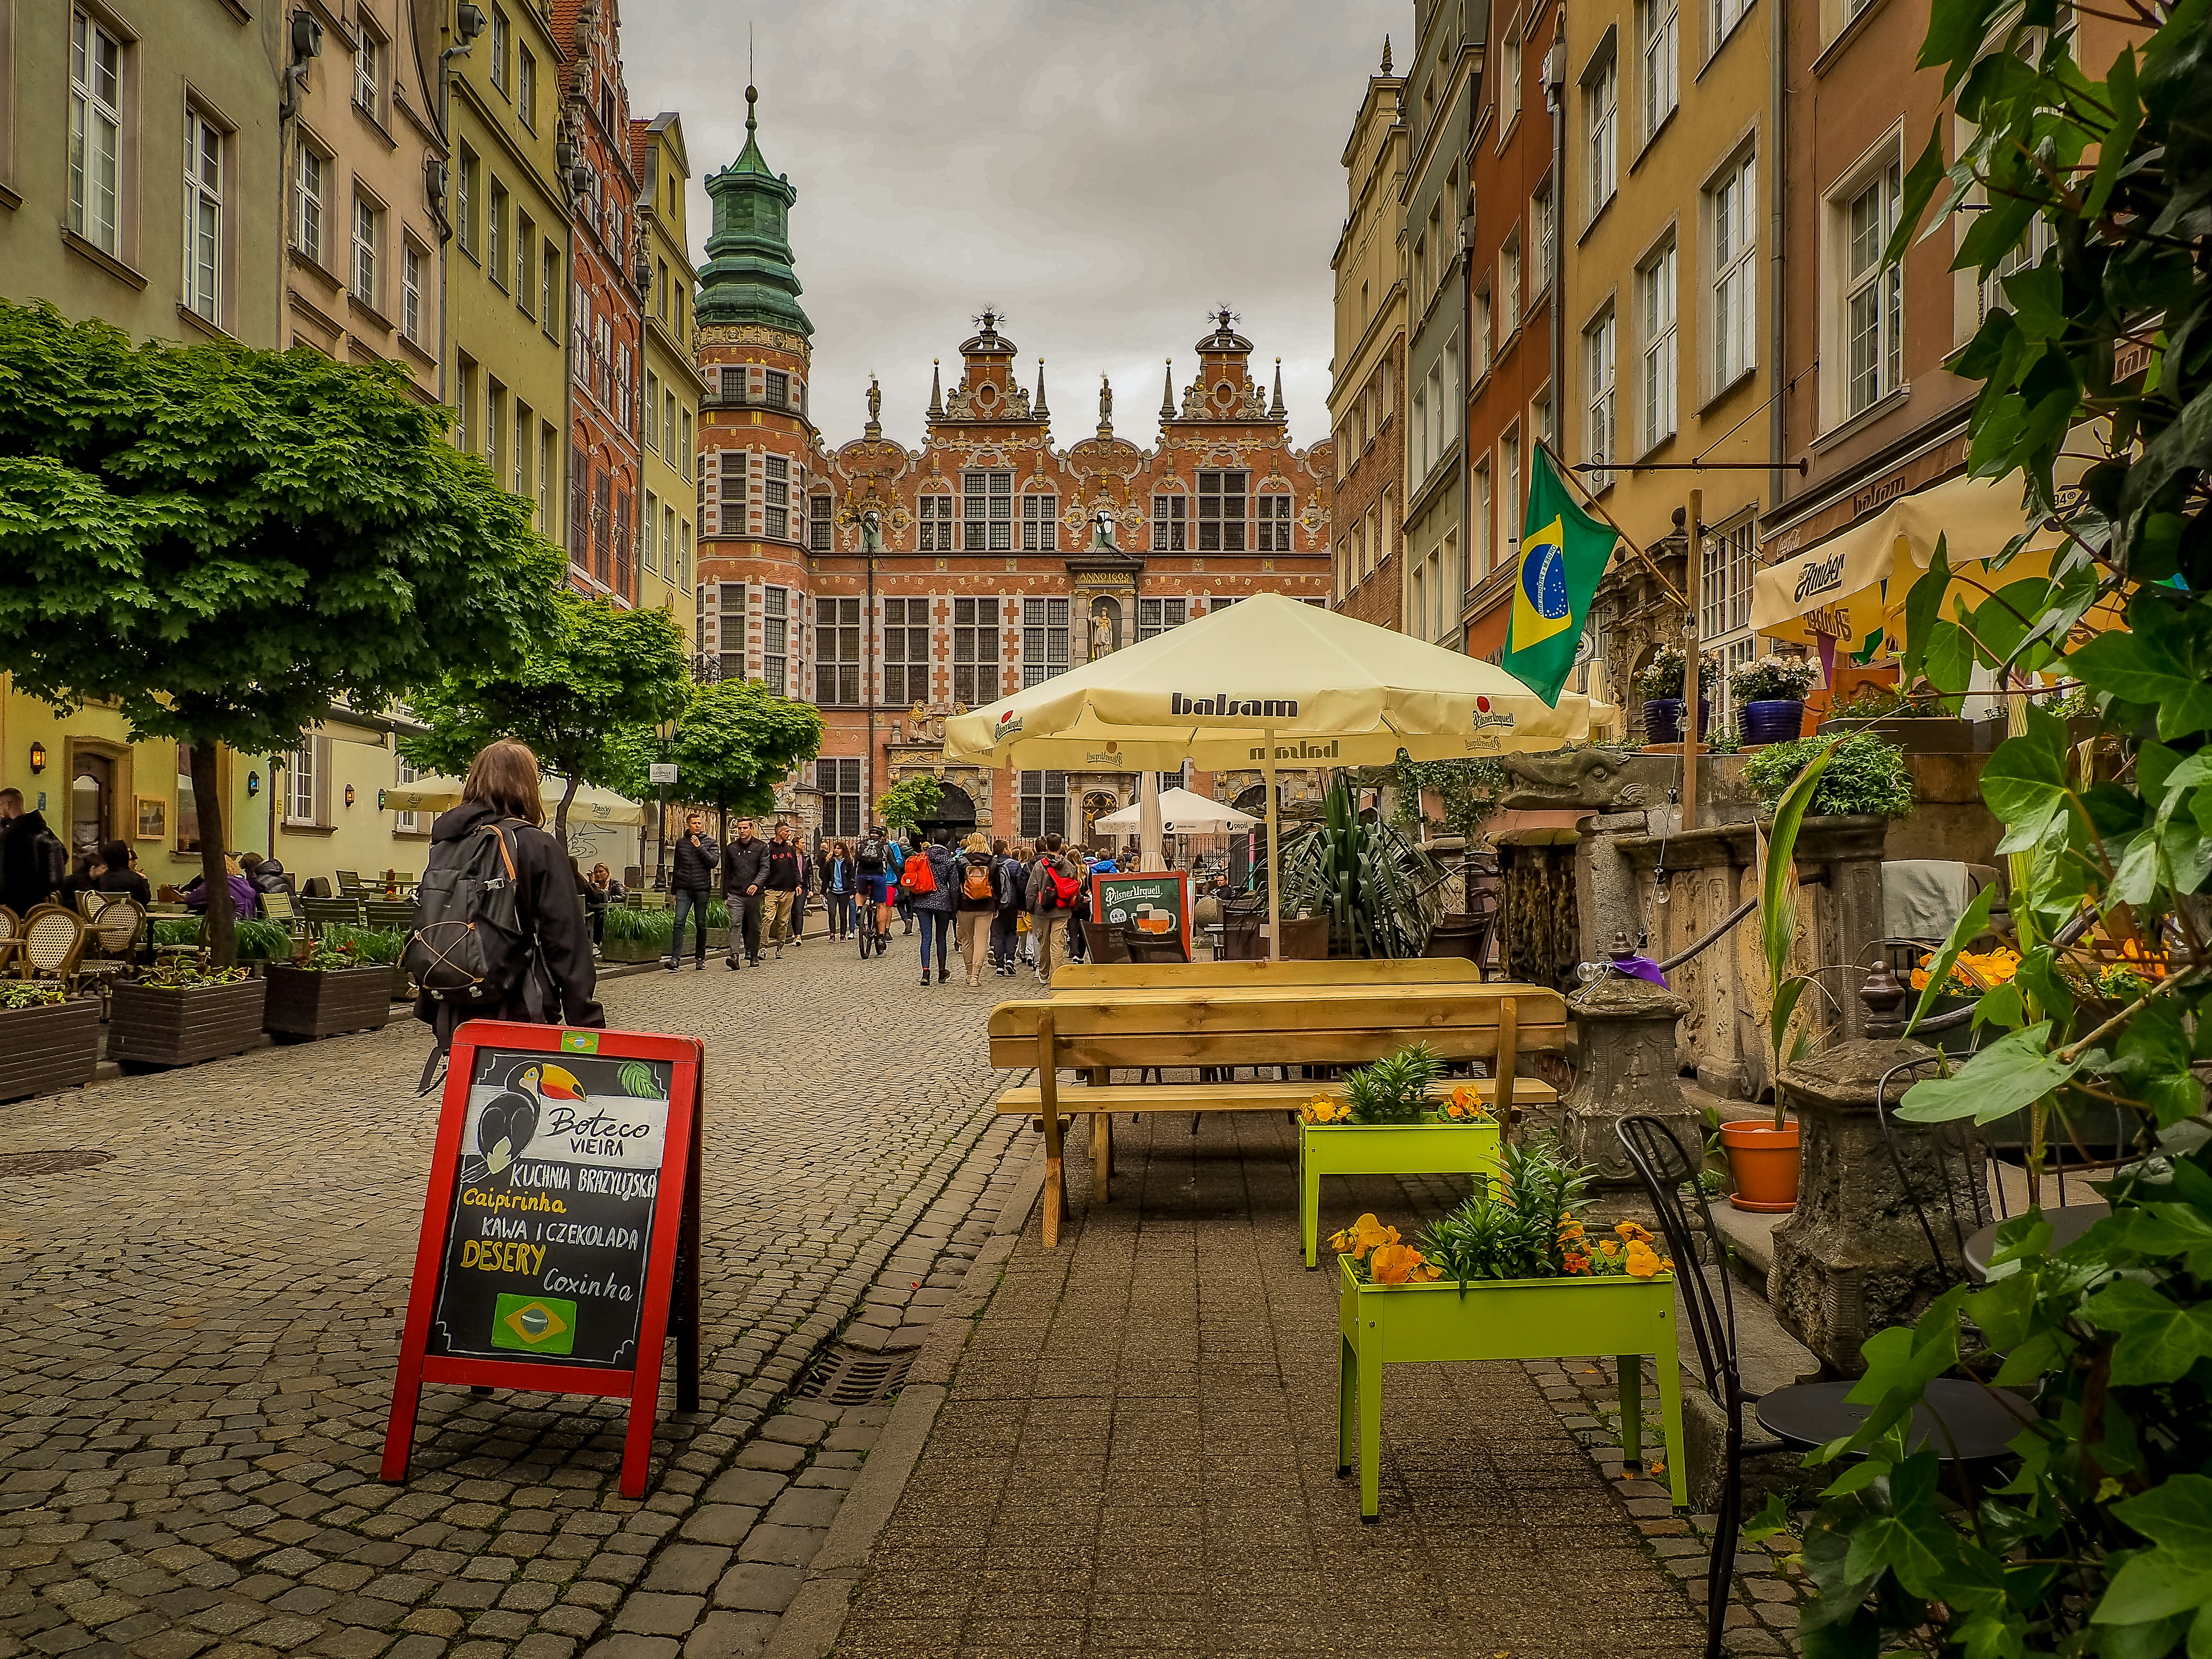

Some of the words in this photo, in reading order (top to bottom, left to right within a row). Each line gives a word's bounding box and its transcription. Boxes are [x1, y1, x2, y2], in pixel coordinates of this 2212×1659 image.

[1794, 553, 1845, 603] Amber
[1171, 692, 1298, 717] balsam
[1472, 710, 1492, 731] Pilsner
[1106, 887, 1134, 907] Pilsner
[539, 1107, 650, 1138] Boteco
[570, 1137, 624, 1157] VIEIRA
[510, 1163, 571, 1191] KUCHNIA
[577, 1168, 657, 1201] BRAZYLIJSKA
[463, 1187, 567, 1214] Caipirinha
[481, 1217, 527, 1240] KAWA
[536, 1223, 542, 1241] I
[546, 1223, 639, 1251] CZEKOLADA
[460, 1239, 546, 1276] DESERY
[543, 1268, 634, 1302] Coxinha
